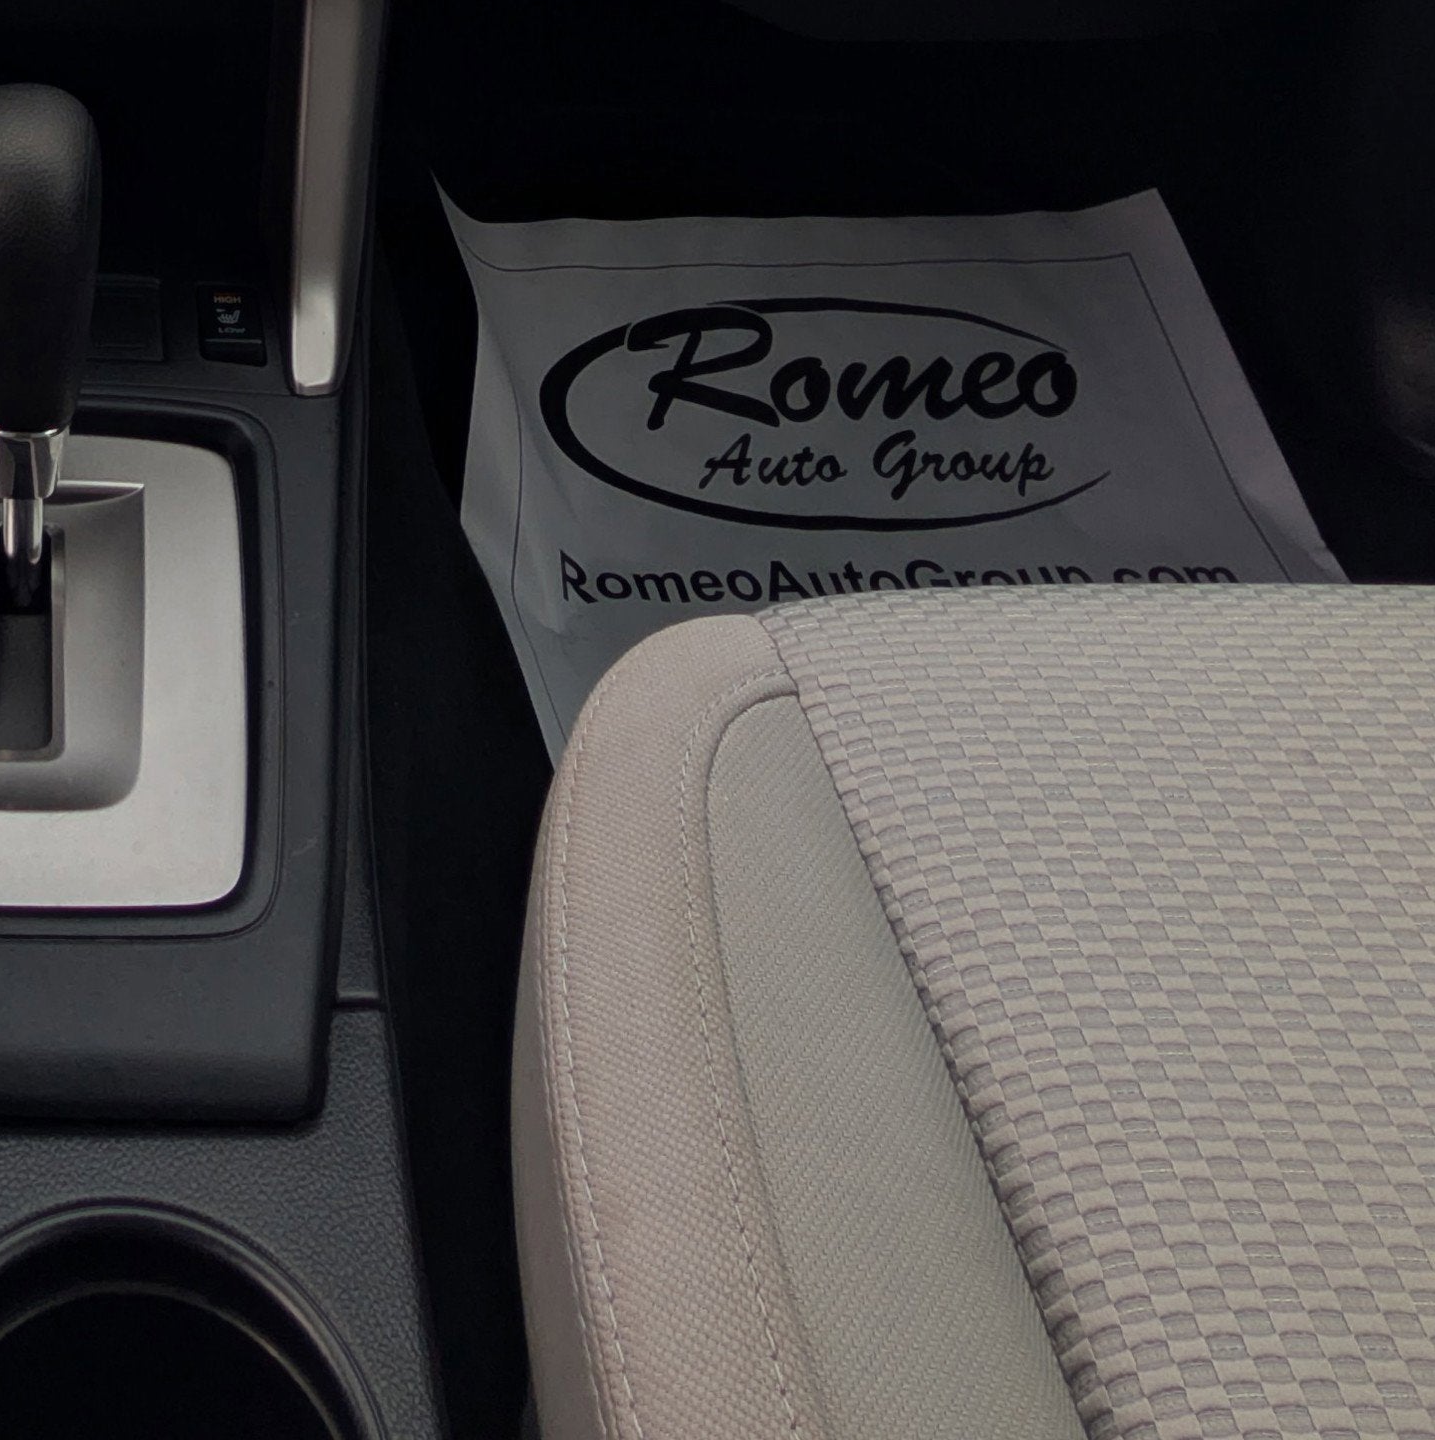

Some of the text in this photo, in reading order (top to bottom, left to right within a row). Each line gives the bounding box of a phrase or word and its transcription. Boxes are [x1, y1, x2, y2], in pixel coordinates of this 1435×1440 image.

[626, 306, 1077, 431] Romeo
[699, 430, 1054, 500] Auto Group
